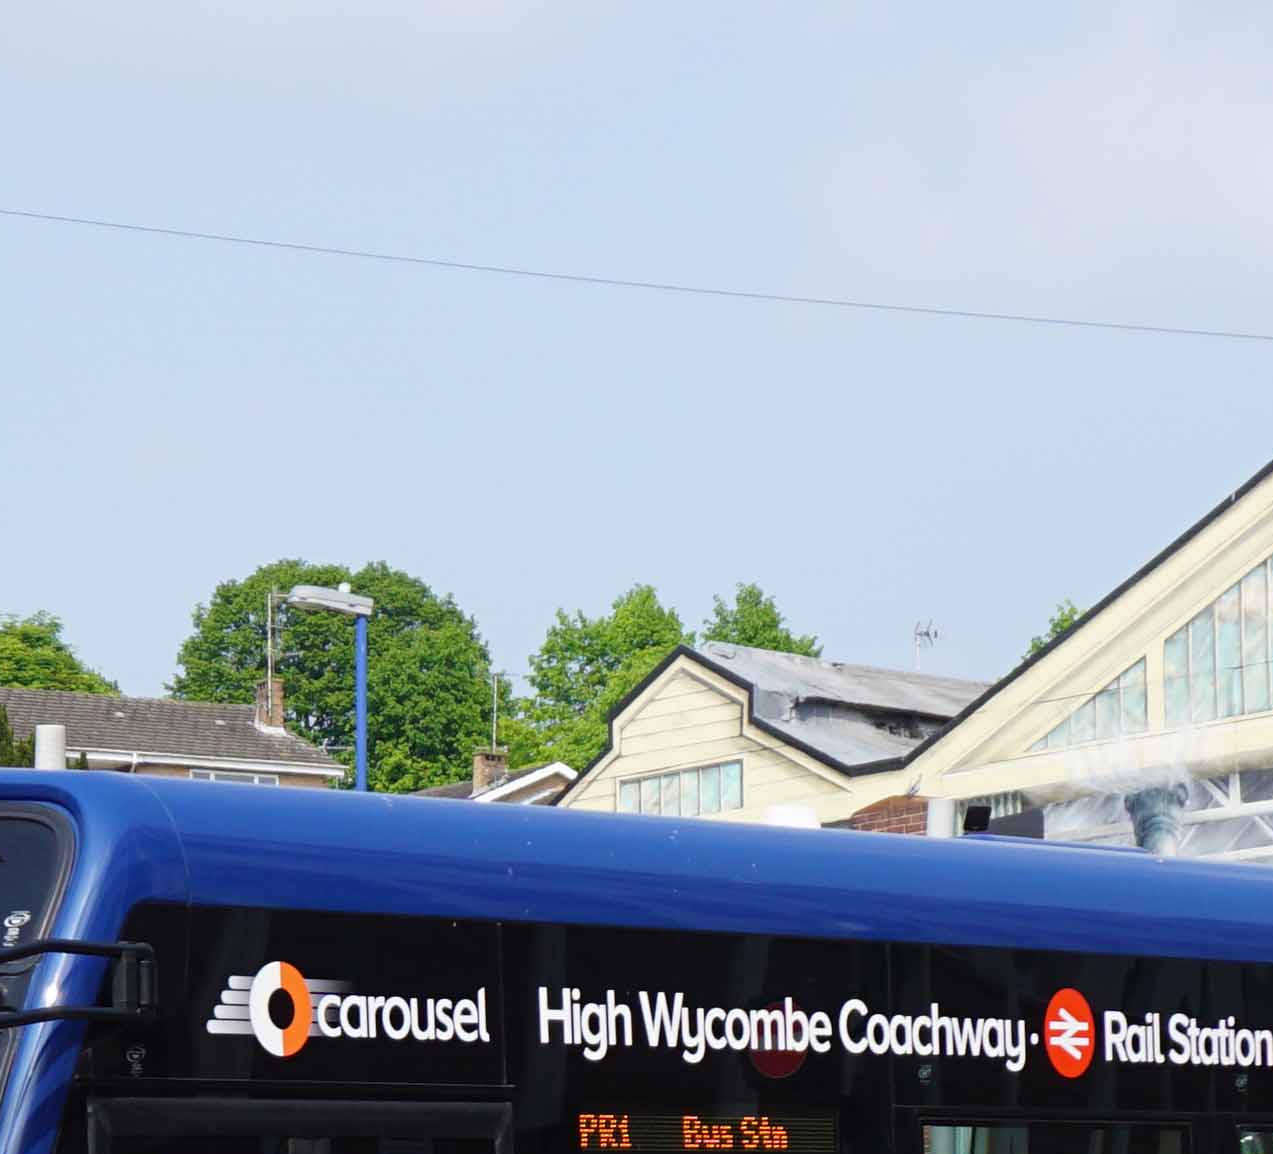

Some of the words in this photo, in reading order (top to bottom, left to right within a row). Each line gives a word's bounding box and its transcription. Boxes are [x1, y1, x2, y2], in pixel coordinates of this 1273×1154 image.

[317, 986, 491, 1042] carousel
[538, 986, 633, 1062] High
[638, 990, 832, 1064] Wycombe
[839, 999, 1029, 1072] Coachway
[1104, 1010, 1165, 1064] Rail
[579, 1114, 632, 1148] PR1
[683, 1115, 733, 1149] Bus
[741, 1116, 788, 1149] Stn
